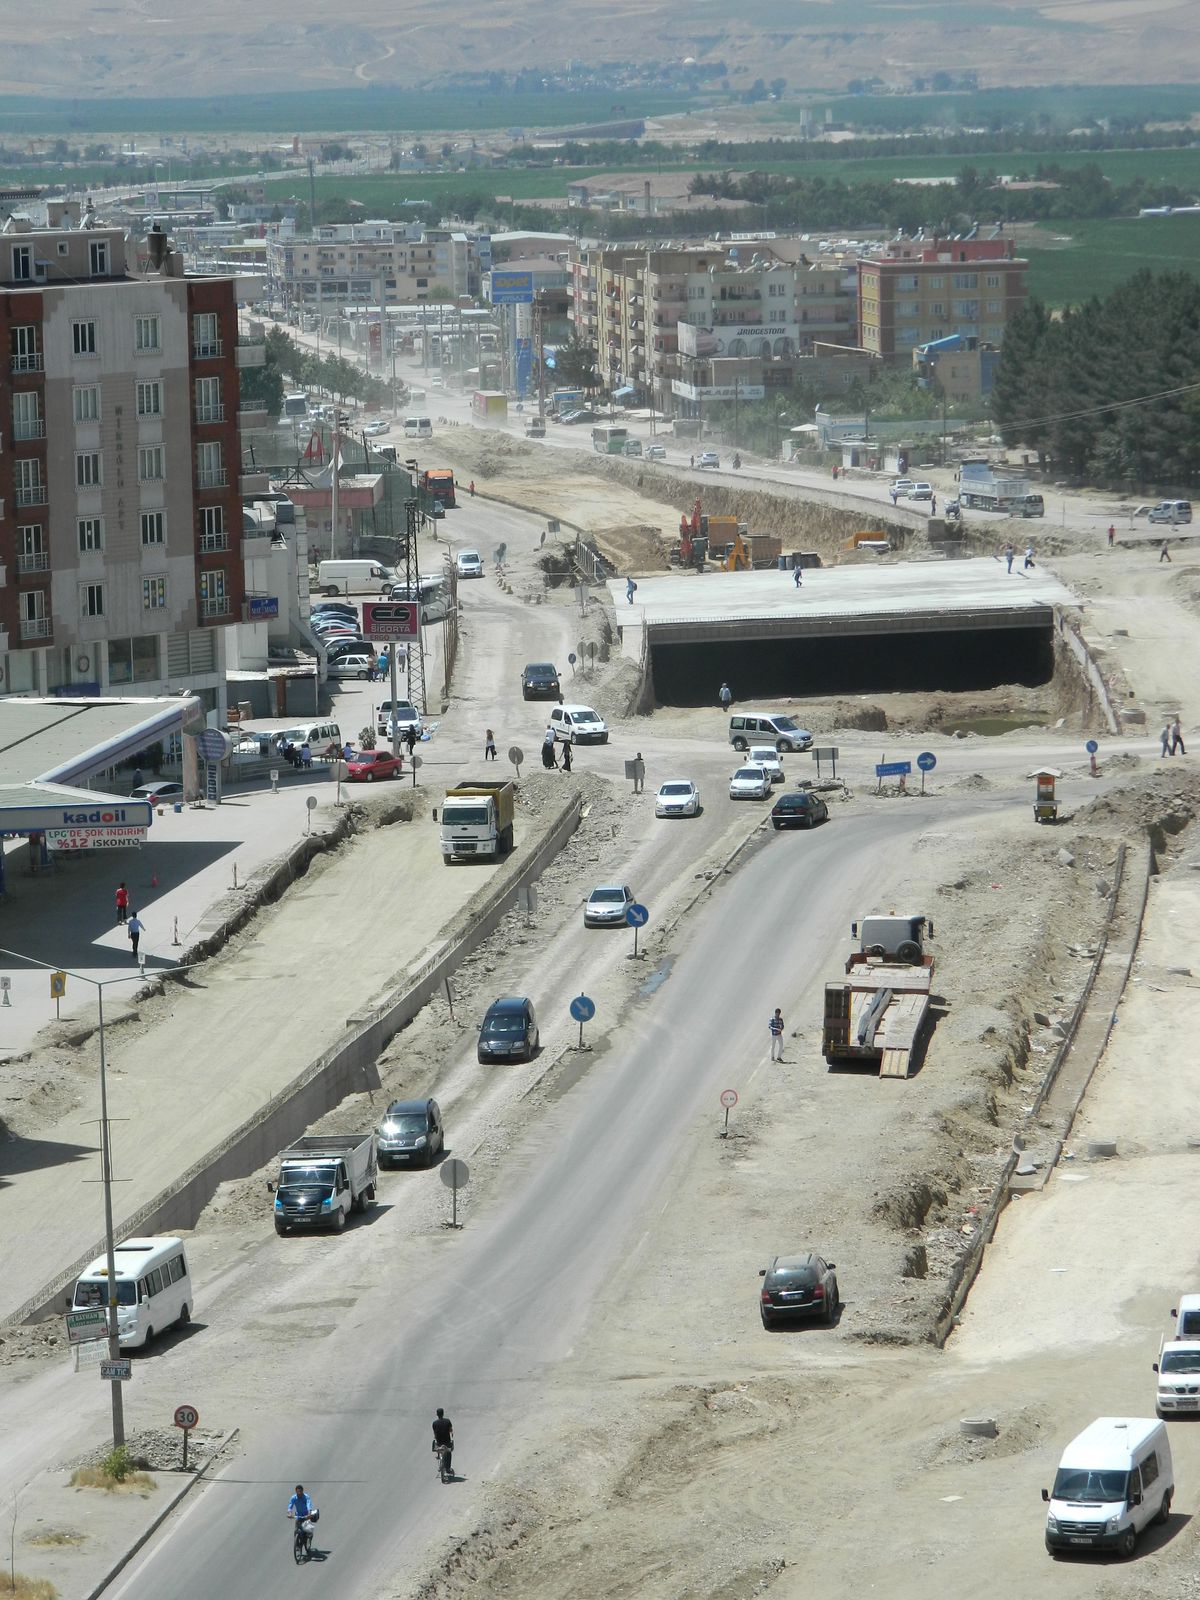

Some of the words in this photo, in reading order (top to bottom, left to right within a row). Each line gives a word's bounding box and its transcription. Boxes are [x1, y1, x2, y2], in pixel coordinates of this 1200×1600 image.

[736, 327, 786, 336] BRIDGESTONE
[63, 809, 126, 824] kadoil
[49, 829, 82, 839] LPG'DE
[86, 828, 104, 839] ŞOK
[57, 838, 88, 849] %12
[179, 1411, 194, 1423] 30
